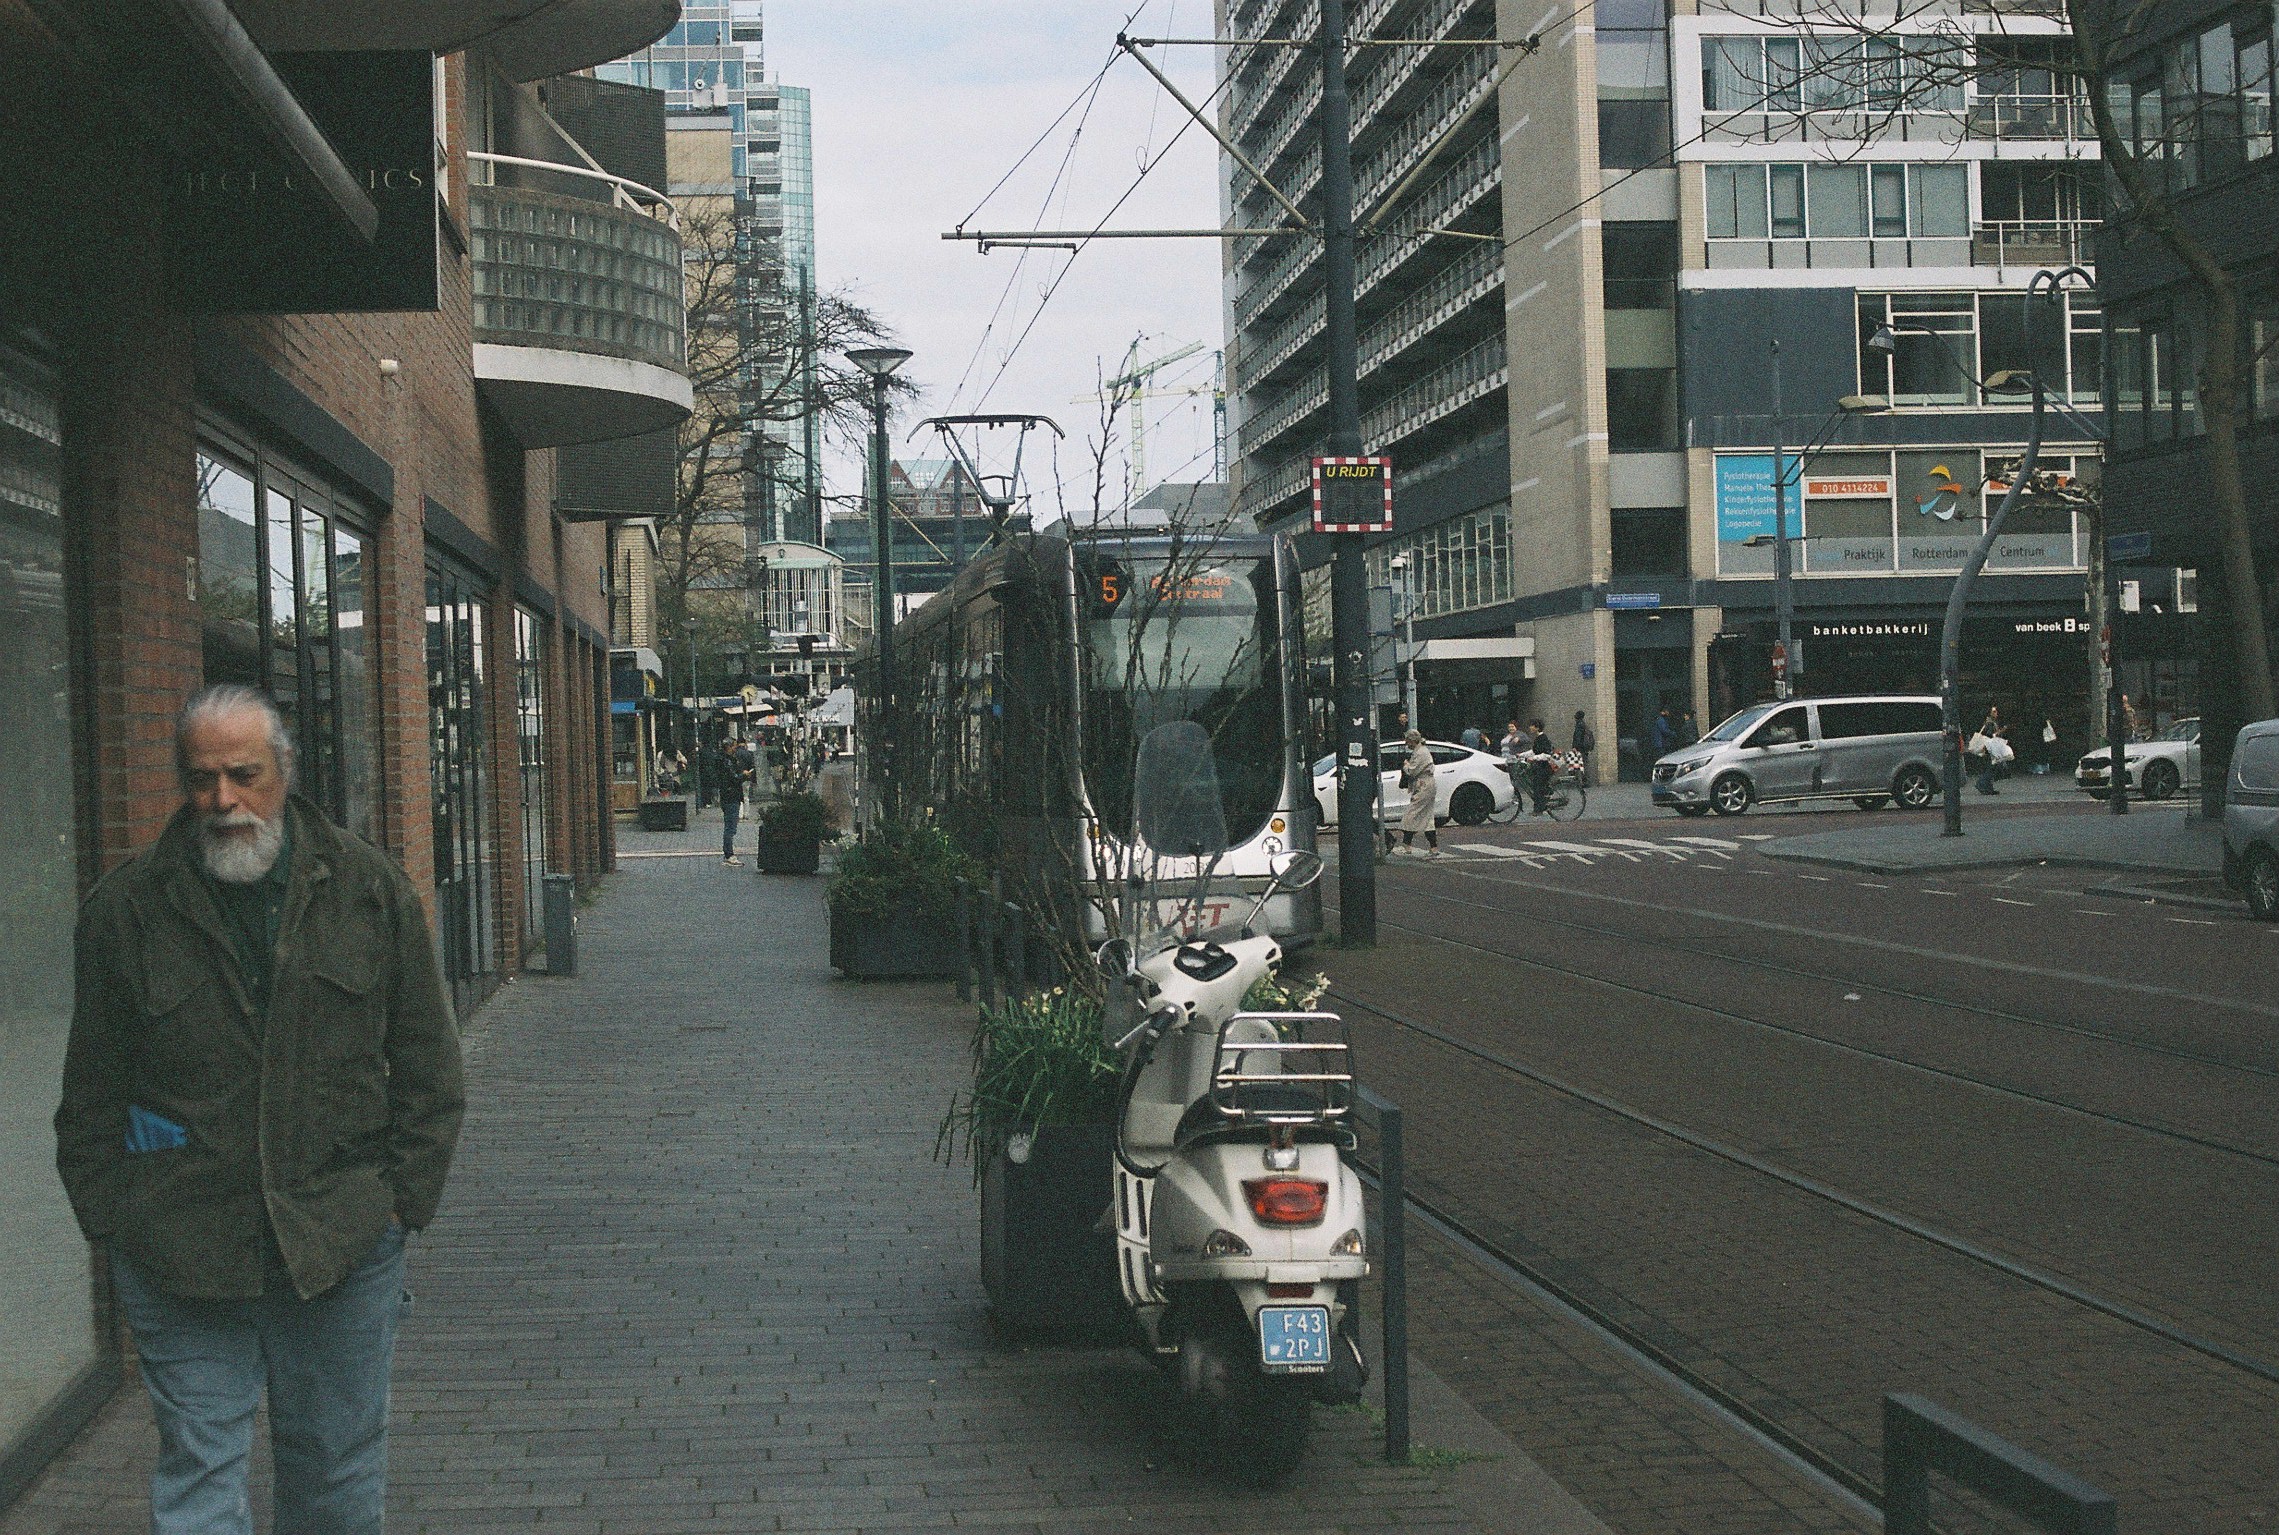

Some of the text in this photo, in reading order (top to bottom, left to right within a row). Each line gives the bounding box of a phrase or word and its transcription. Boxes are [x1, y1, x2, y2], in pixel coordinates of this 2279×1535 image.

[1326, 466, 1377, 478] U RIJDT
[1822, 484, 1838, 493] 010
[1843, 548, 1885, 562] Praktijk
[1912, 547, 1969, 559] Rotterdam
[2000, 546, 2044, 558] Centrum
[1102, 576, 1119, 603] 5
[1813, 624, 1928, 636] banketbakkerij
[2015, 624, 2034, 632] van
[2036, 622, 2061, 632] beek
[1283, 1313, 1322, 1334] F43
[1285, 1337, 1323, 1358] 2PJ
[1288, 1365, 1325, 1374] Scooters
